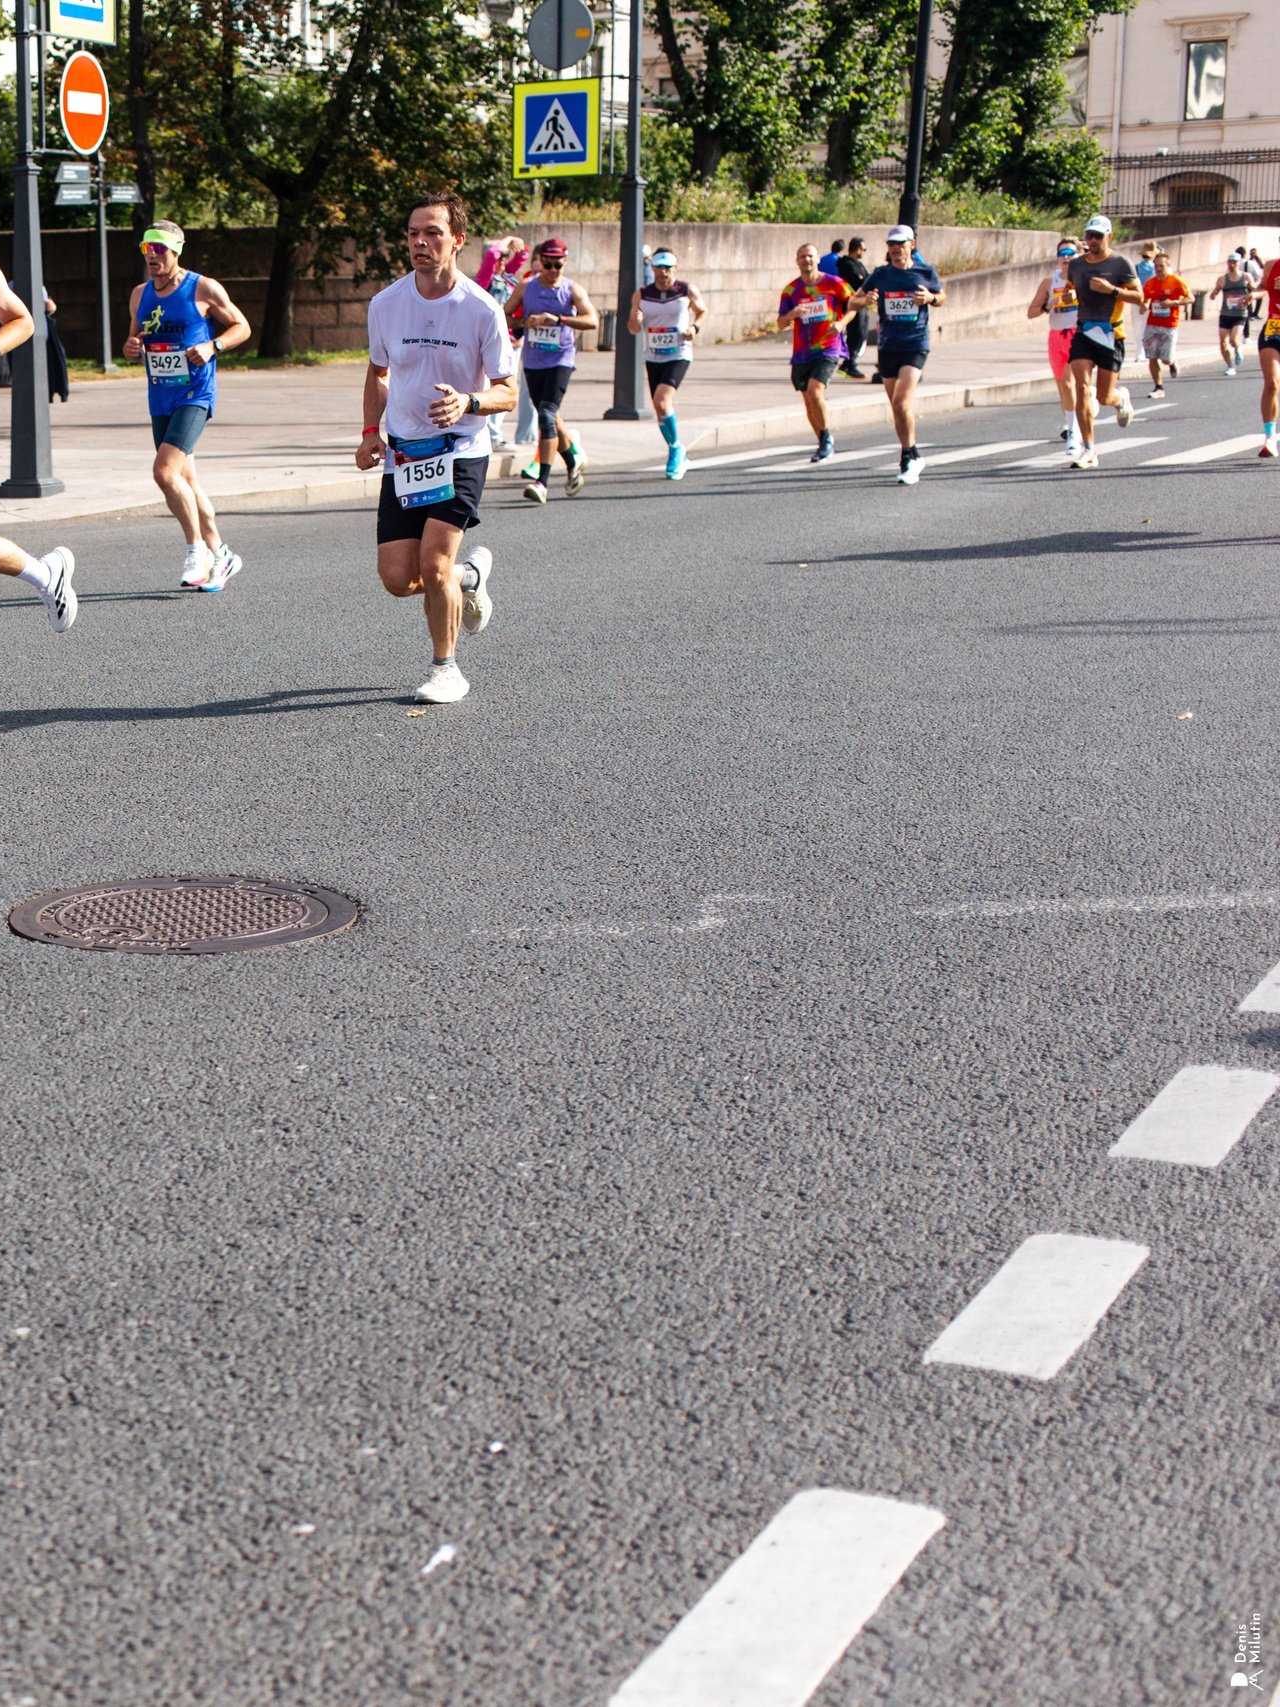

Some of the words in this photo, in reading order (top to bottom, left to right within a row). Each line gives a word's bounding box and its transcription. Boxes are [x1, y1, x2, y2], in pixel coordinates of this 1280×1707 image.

[889, 300, 915, 310] 3629
[652, 335, 674, 344] 6922
[151, 355, 182, 369] 5492
[403, 458, 445, 484] 1556
[401, 496, 408, 507] D
